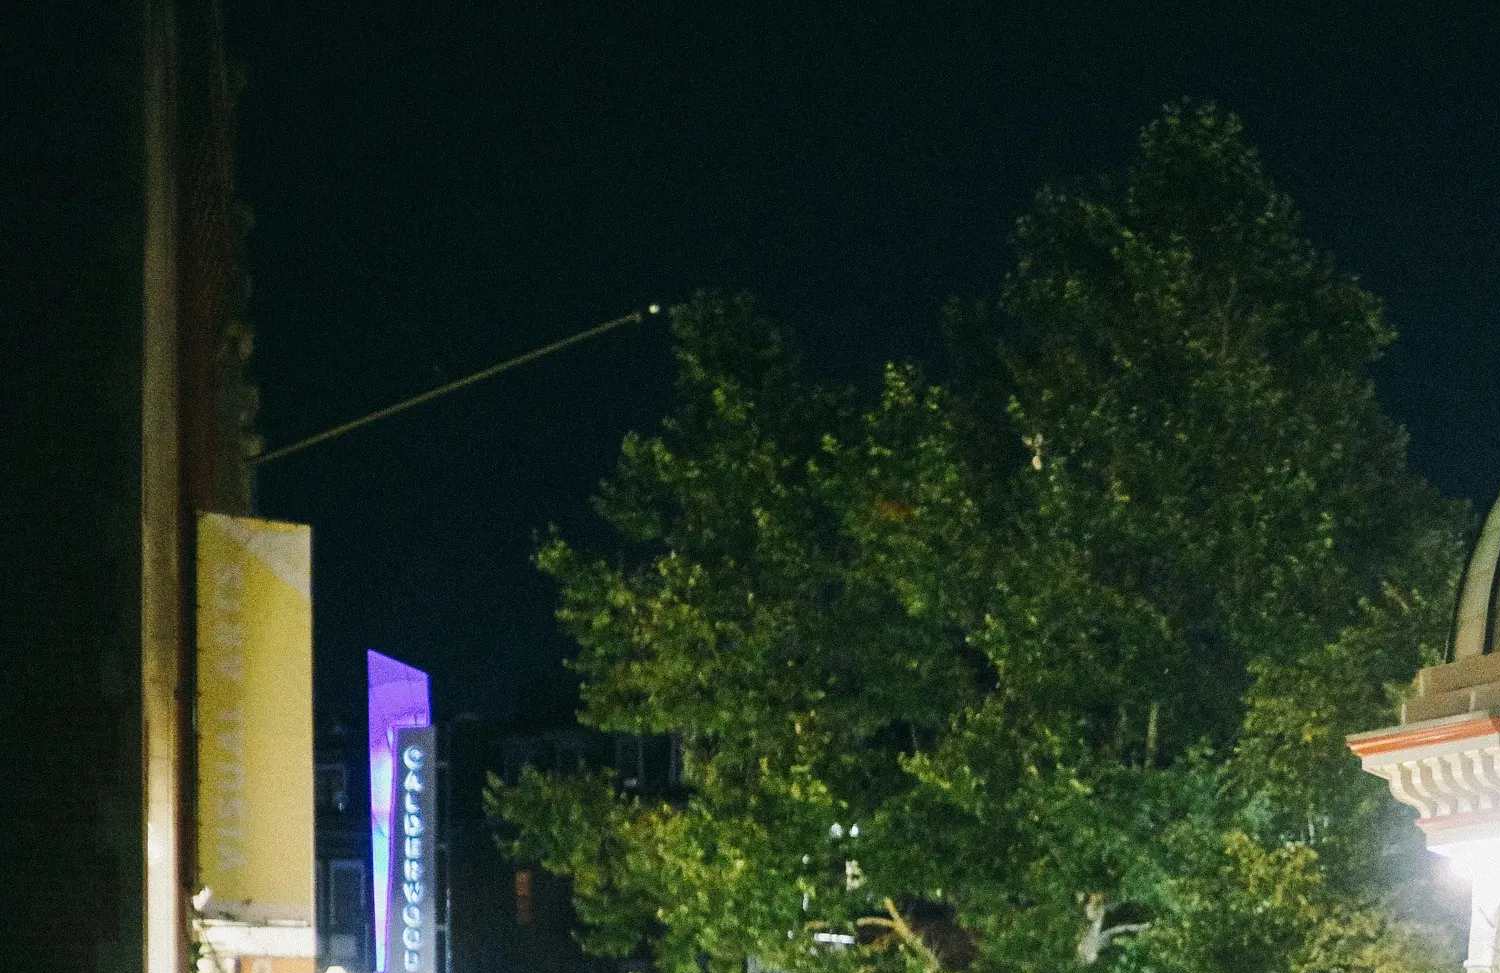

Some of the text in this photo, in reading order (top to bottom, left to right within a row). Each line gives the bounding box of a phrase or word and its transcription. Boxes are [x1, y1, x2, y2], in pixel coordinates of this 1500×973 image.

[212, 563, 245, 872] VISUAL ARTS
[403, 745, 425, 973] CALDERWOOD
